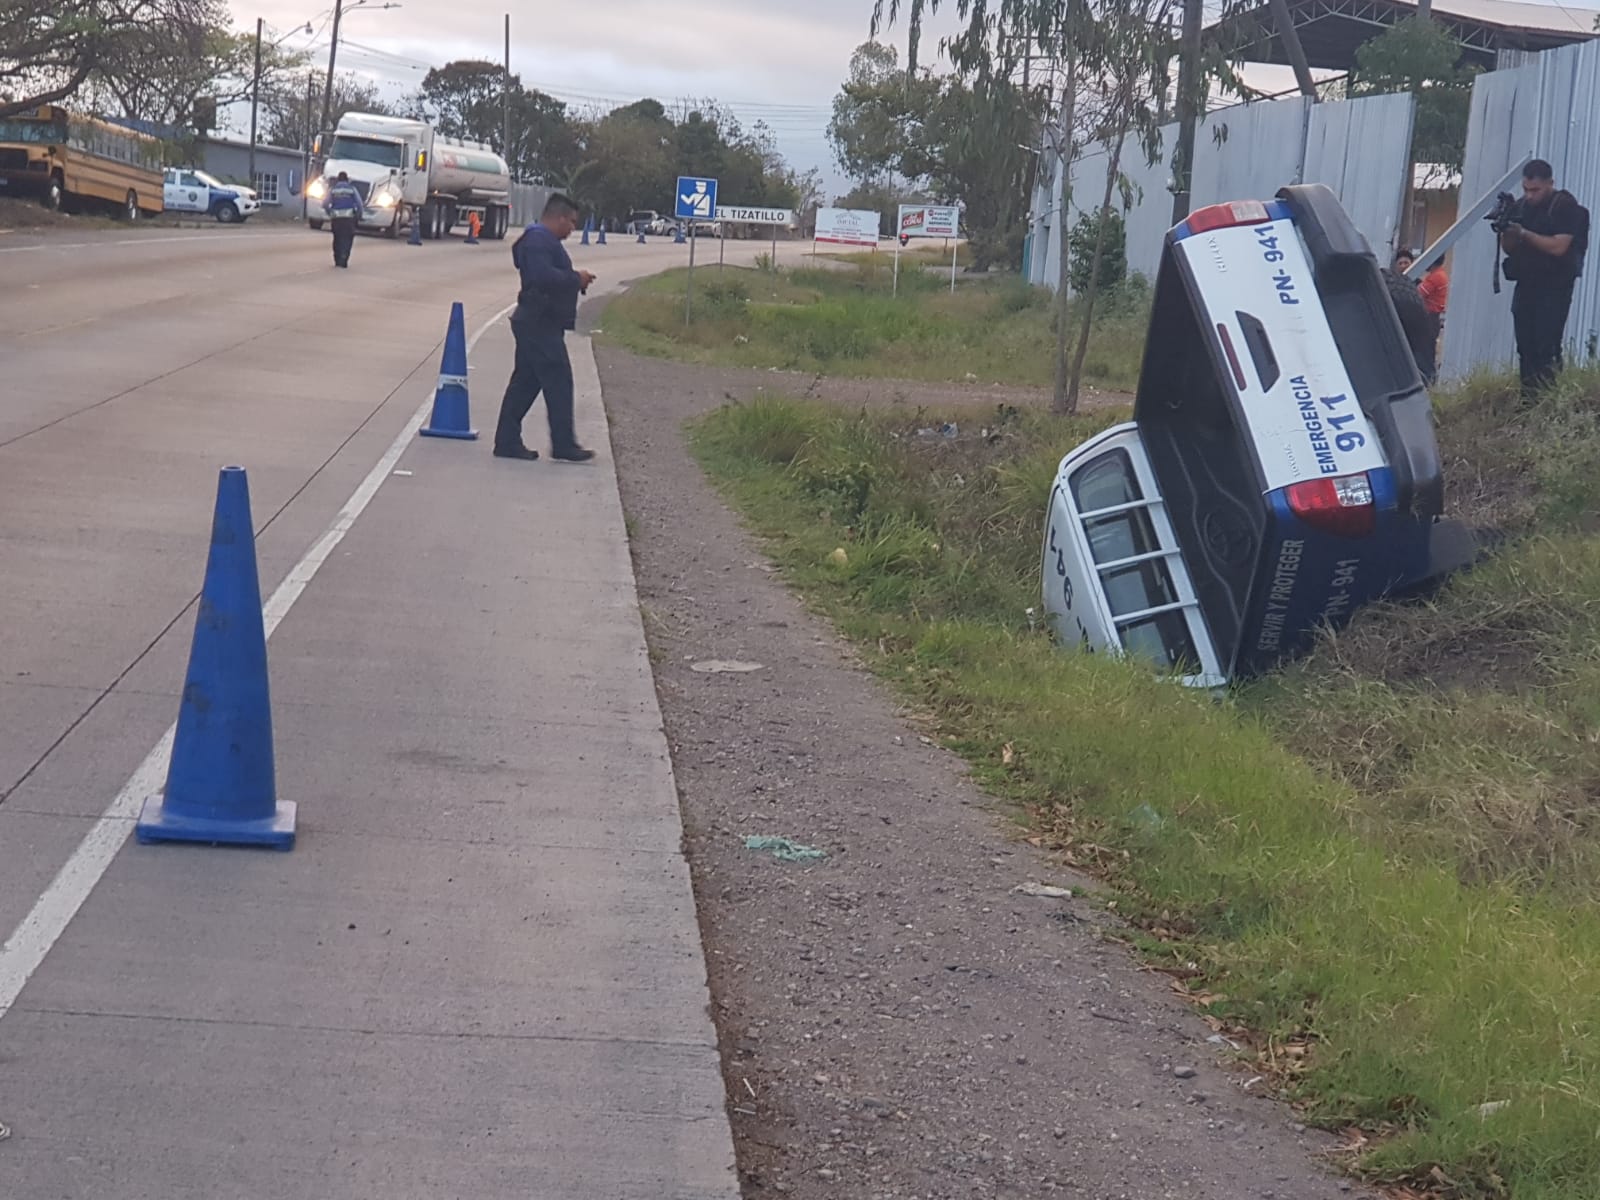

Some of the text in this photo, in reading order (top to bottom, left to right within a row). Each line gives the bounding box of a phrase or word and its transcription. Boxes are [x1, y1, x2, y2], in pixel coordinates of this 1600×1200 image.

[715, 209, 785, 221] EL TIZATILLO
[1254, 225, 1284, 262] 941
[1289, 374, 1338, 474] EMERGENCIA
[1320, 393, 1366, 452] 911
[1257, 539, 1305, 651] SERVIR Y PROTEGER
